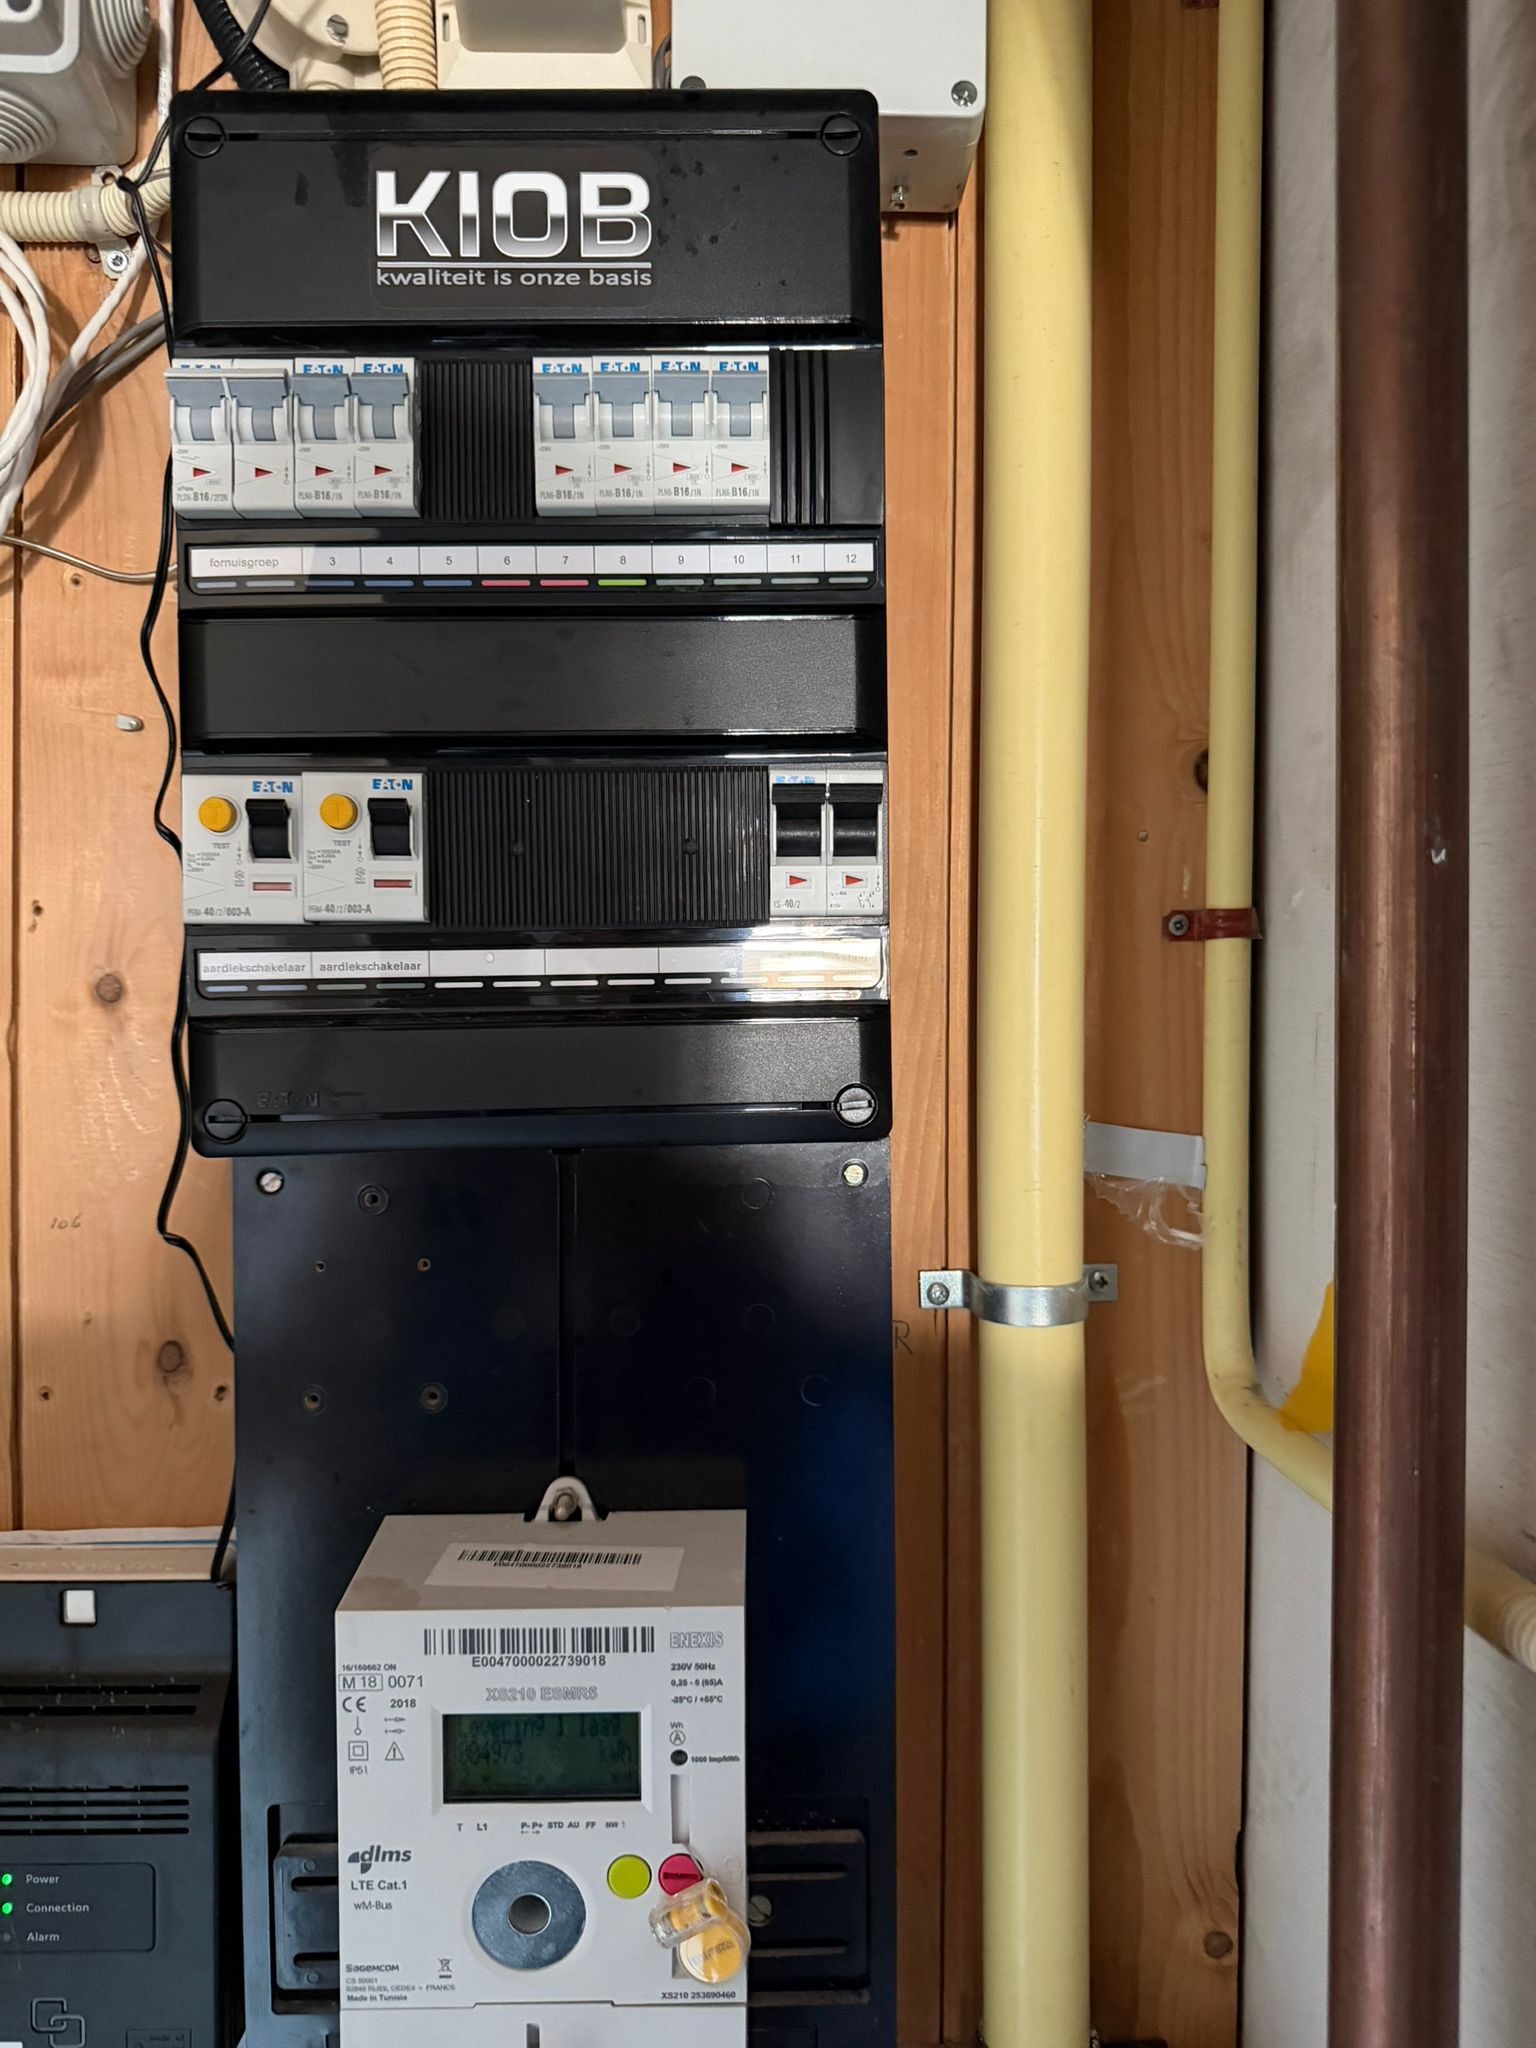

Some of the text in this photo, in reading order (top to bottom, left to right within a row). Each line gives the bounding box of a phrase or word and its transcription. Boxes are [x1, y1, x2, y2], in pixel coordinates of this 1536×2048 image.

[376, 170, 652, 258] KIOB
[376, 269, 652, 286] kwaliteit is onze basis
[209, 554, 857, 569] fornuisgroep 3 4 5 6 7 8 9 10 11 12
[252, 780, 293, 793] EATON
[372, 778, 414, 790] EATON
[319, 960, 422, 973] aardlekschakelaar
[669, 1631, 724, 1648] ENEXIS
[471, 1654, 607, 1668] E0047000022739018
[670, 1662, 716, 1671] 230V 50Hz
[383, 1663, 397, 1672] ON
[342, 1674, 424, 1689] M 18 0071
[486, 1687, 537, 1702] XS210
[390, 1698, 417, 1709] 2018
[669, 1721, 684, 1730] Wh
[457, 1823, 463, 1832] T
[477, 1822, 488, 1831] L1
[25, 1874, 60, 1885] Power
[350, 1879, 408, 1891] LTE Cat.1
[26, 1902, 90, 1914] Connection
[353, 1900, 393, 1910] wM-Bus
[26, 1932, 60, 1943] Alarm
[346, 1993, 408, 2002] Made in Tunisia
[661, 1991, 689, 2000] XS210
